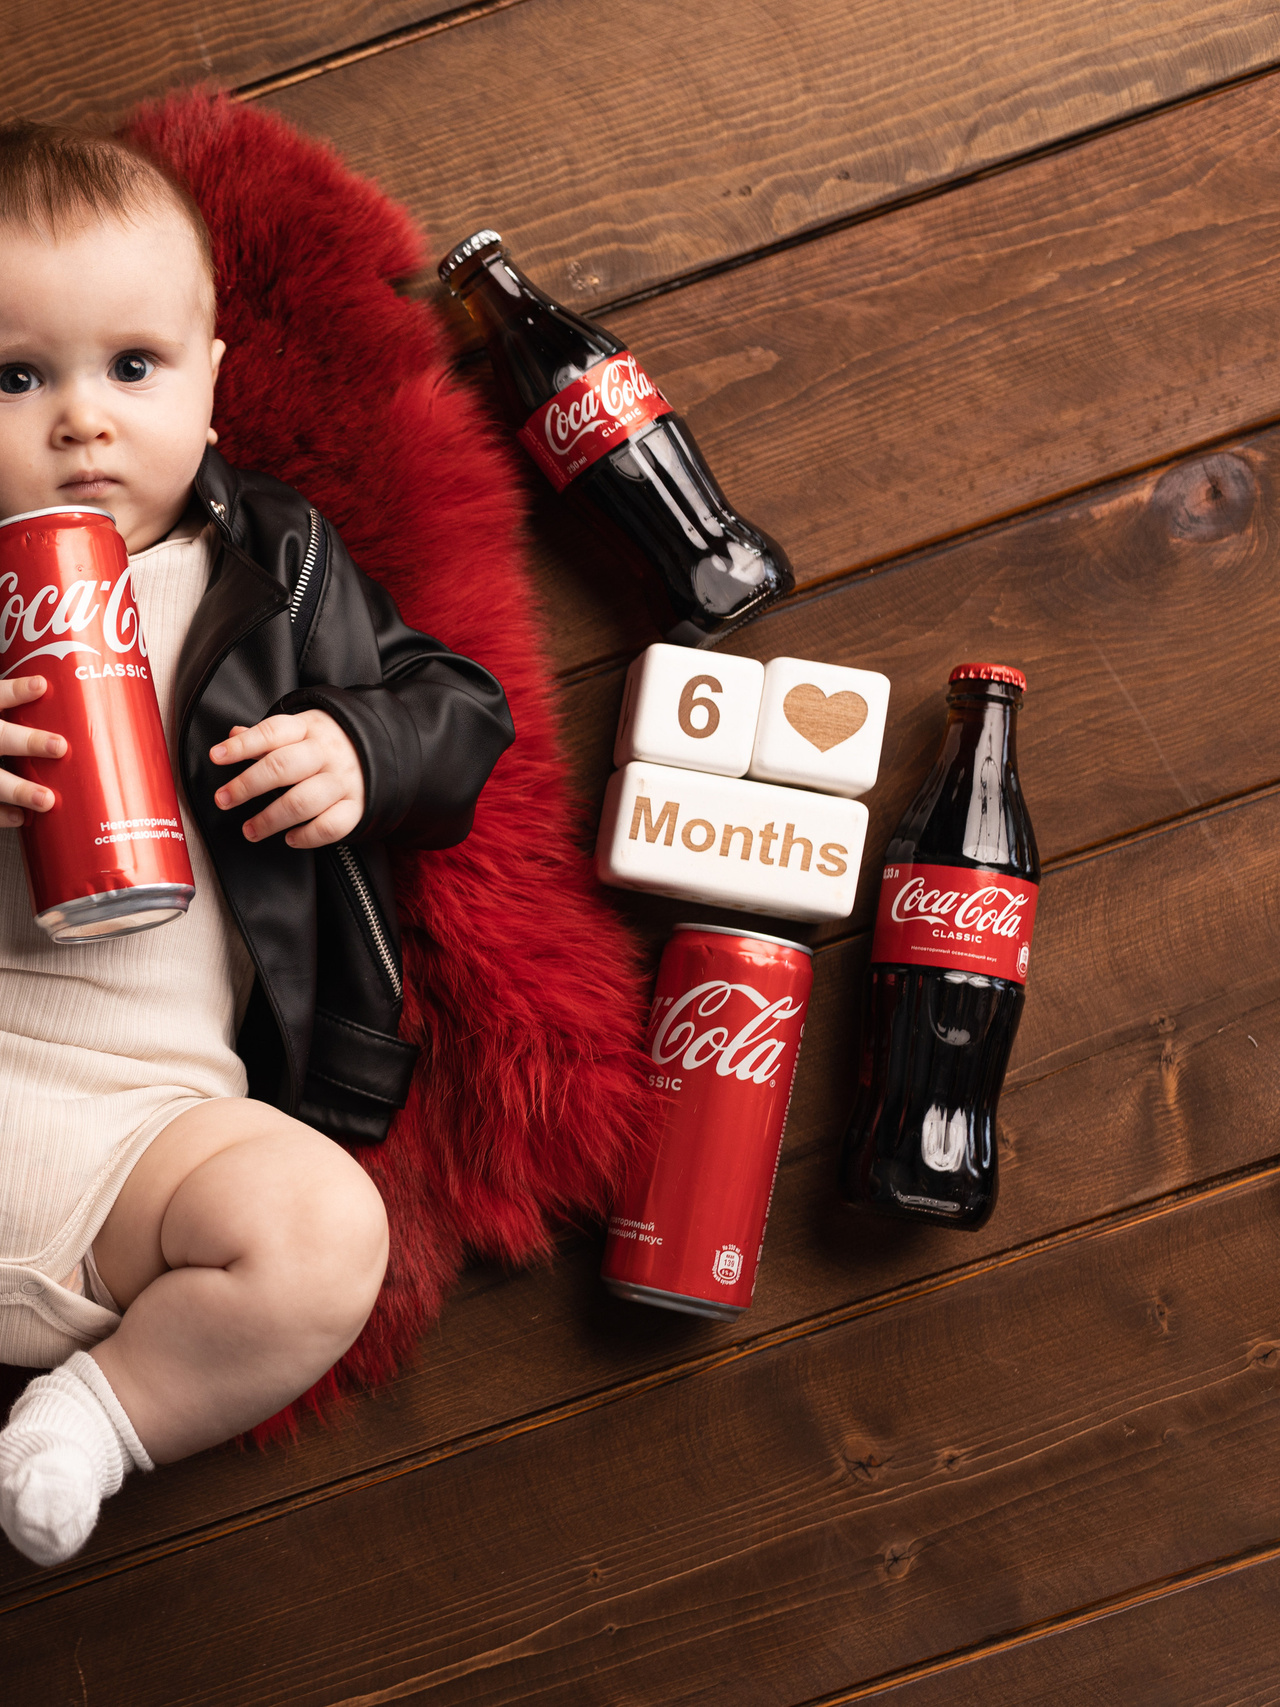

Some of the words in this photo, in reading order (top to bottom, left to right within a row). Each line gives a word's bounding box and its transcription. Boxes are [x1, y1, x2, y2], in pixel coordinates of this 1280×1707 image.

[545, 355, 653, 456] Coca-Cola
[601, 407, 642, 438] CLASSIC
[75, 663, 148, 680] CLASSIC
[678, 674, 724, 739] 6
[100, 817, 178, 832] Неповторимый
[94, 828, 170, 846] освежающий
[628, 795, 849, 877] Months
[891, 877, 1029, 938] Coca-Cola
[932, 929, 983, 944] CLASSIC
[648, 1074, 682, 1091] SSIC
[638, 1232, 664, 1246] вкус
[723, 1258, 736, 1268] 139
